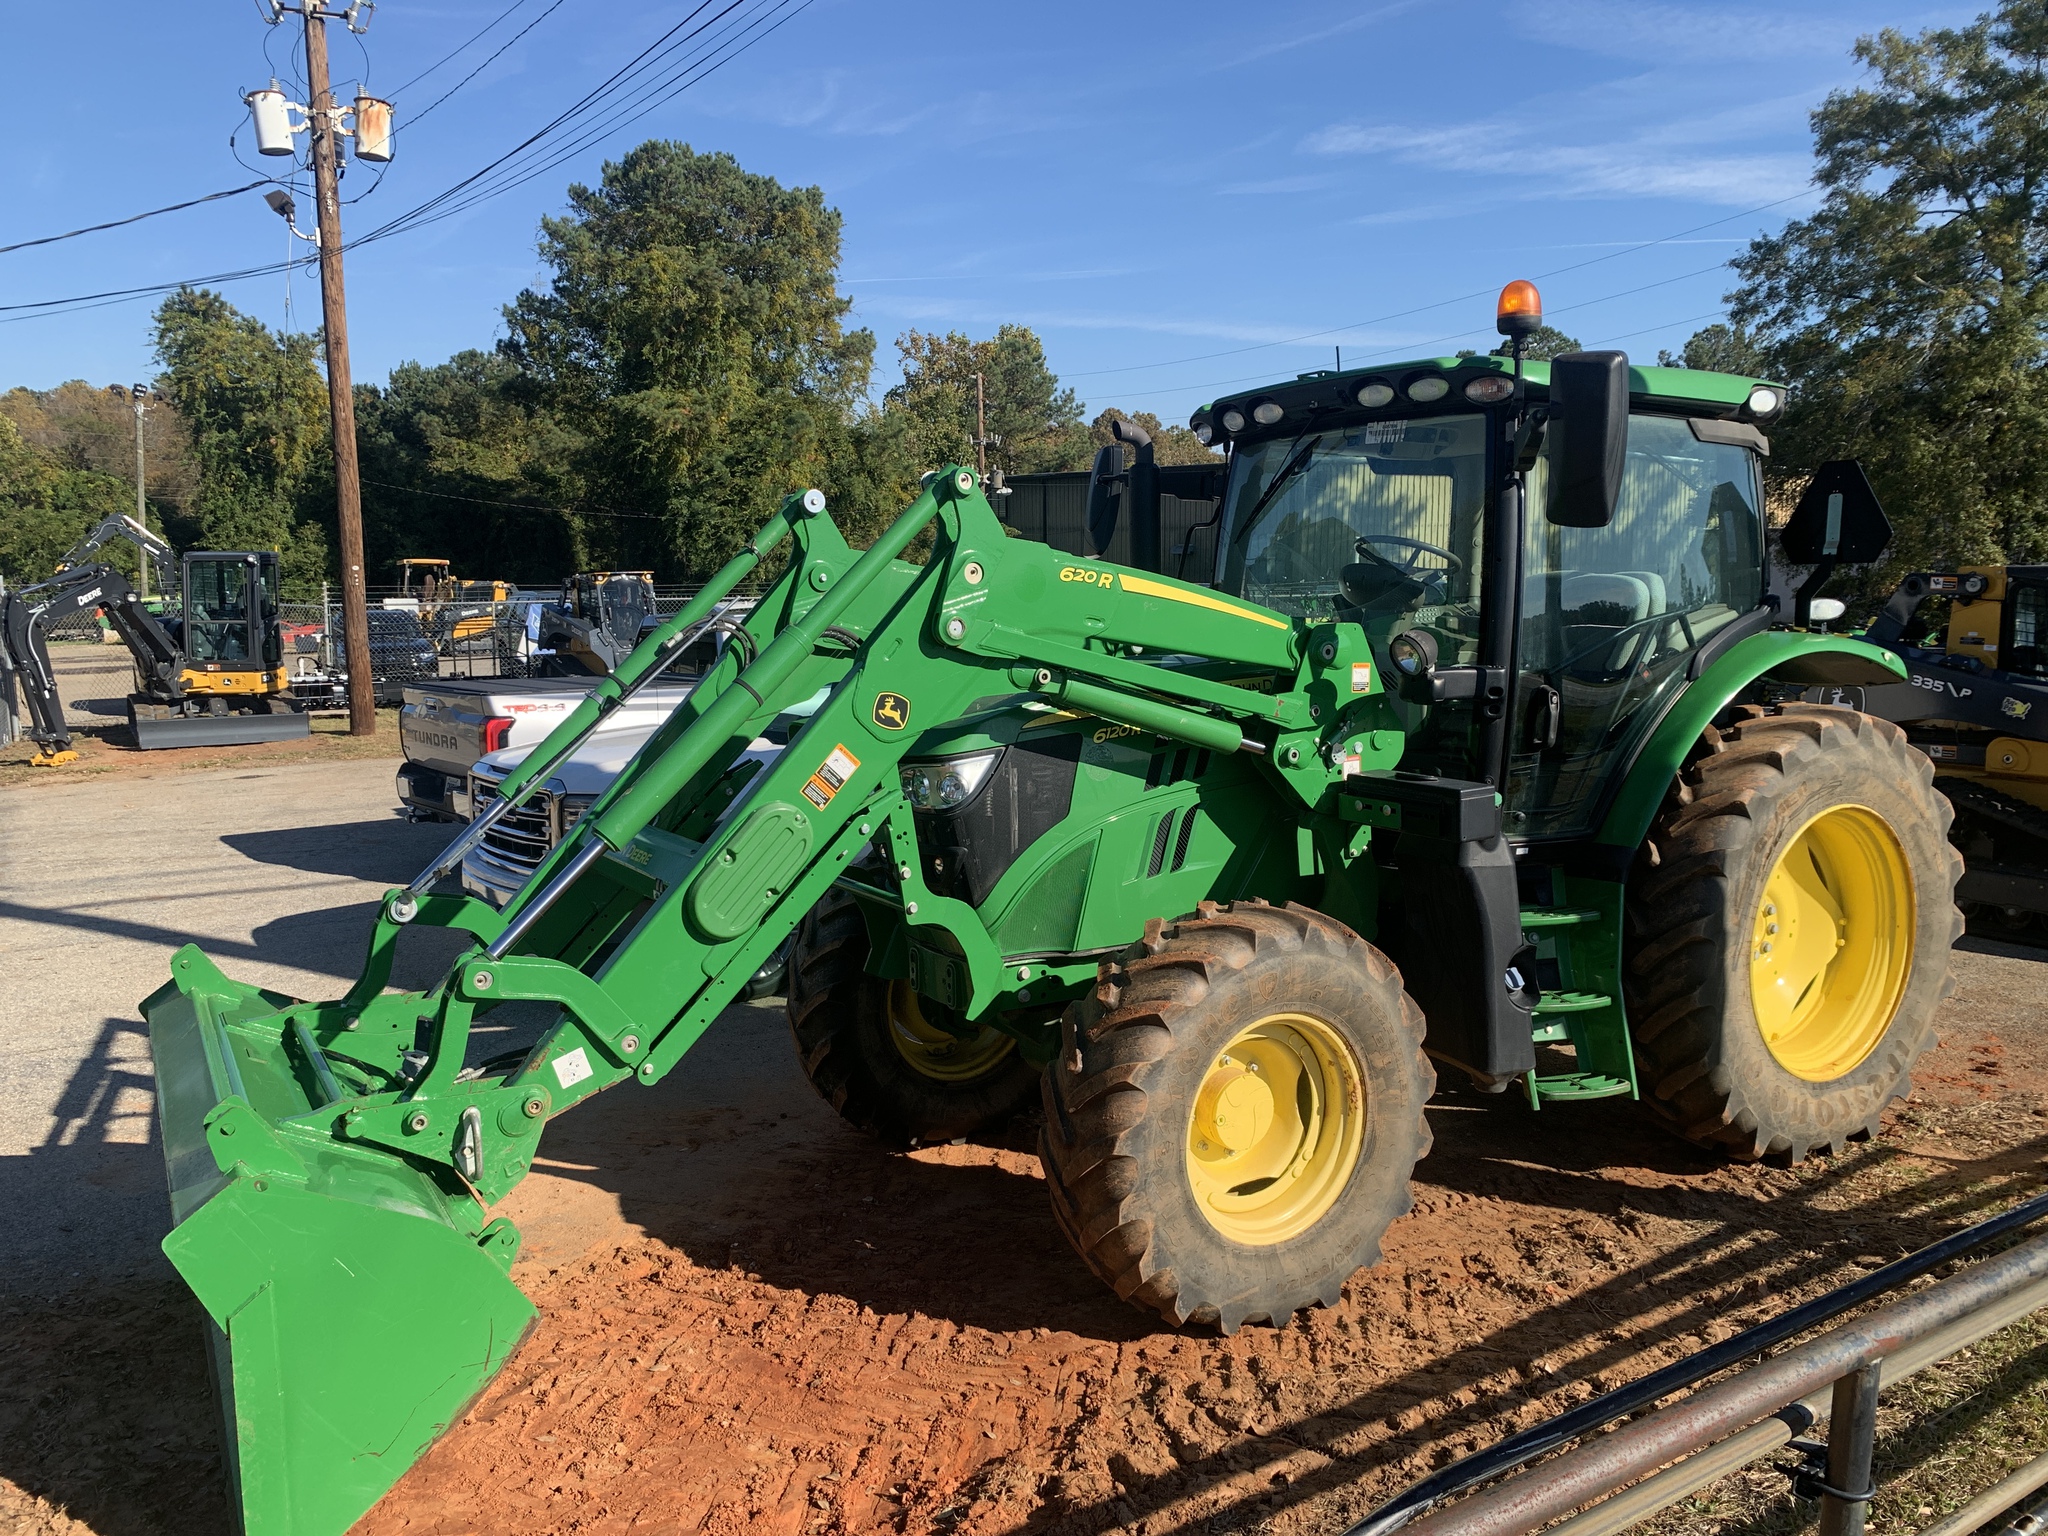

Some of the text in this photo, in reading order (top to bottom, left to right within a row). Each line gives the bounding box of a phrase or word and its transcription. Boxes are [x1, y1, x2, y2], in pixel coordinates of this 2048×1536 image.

[77, 587, 103, 606] DEERE
[1911, 675, 1944, 692] 335
[503, 704, 537, 714] TRD
[413, 729, 458, 750] TUNDRA
[627, 845, 653, 866] DEERE
